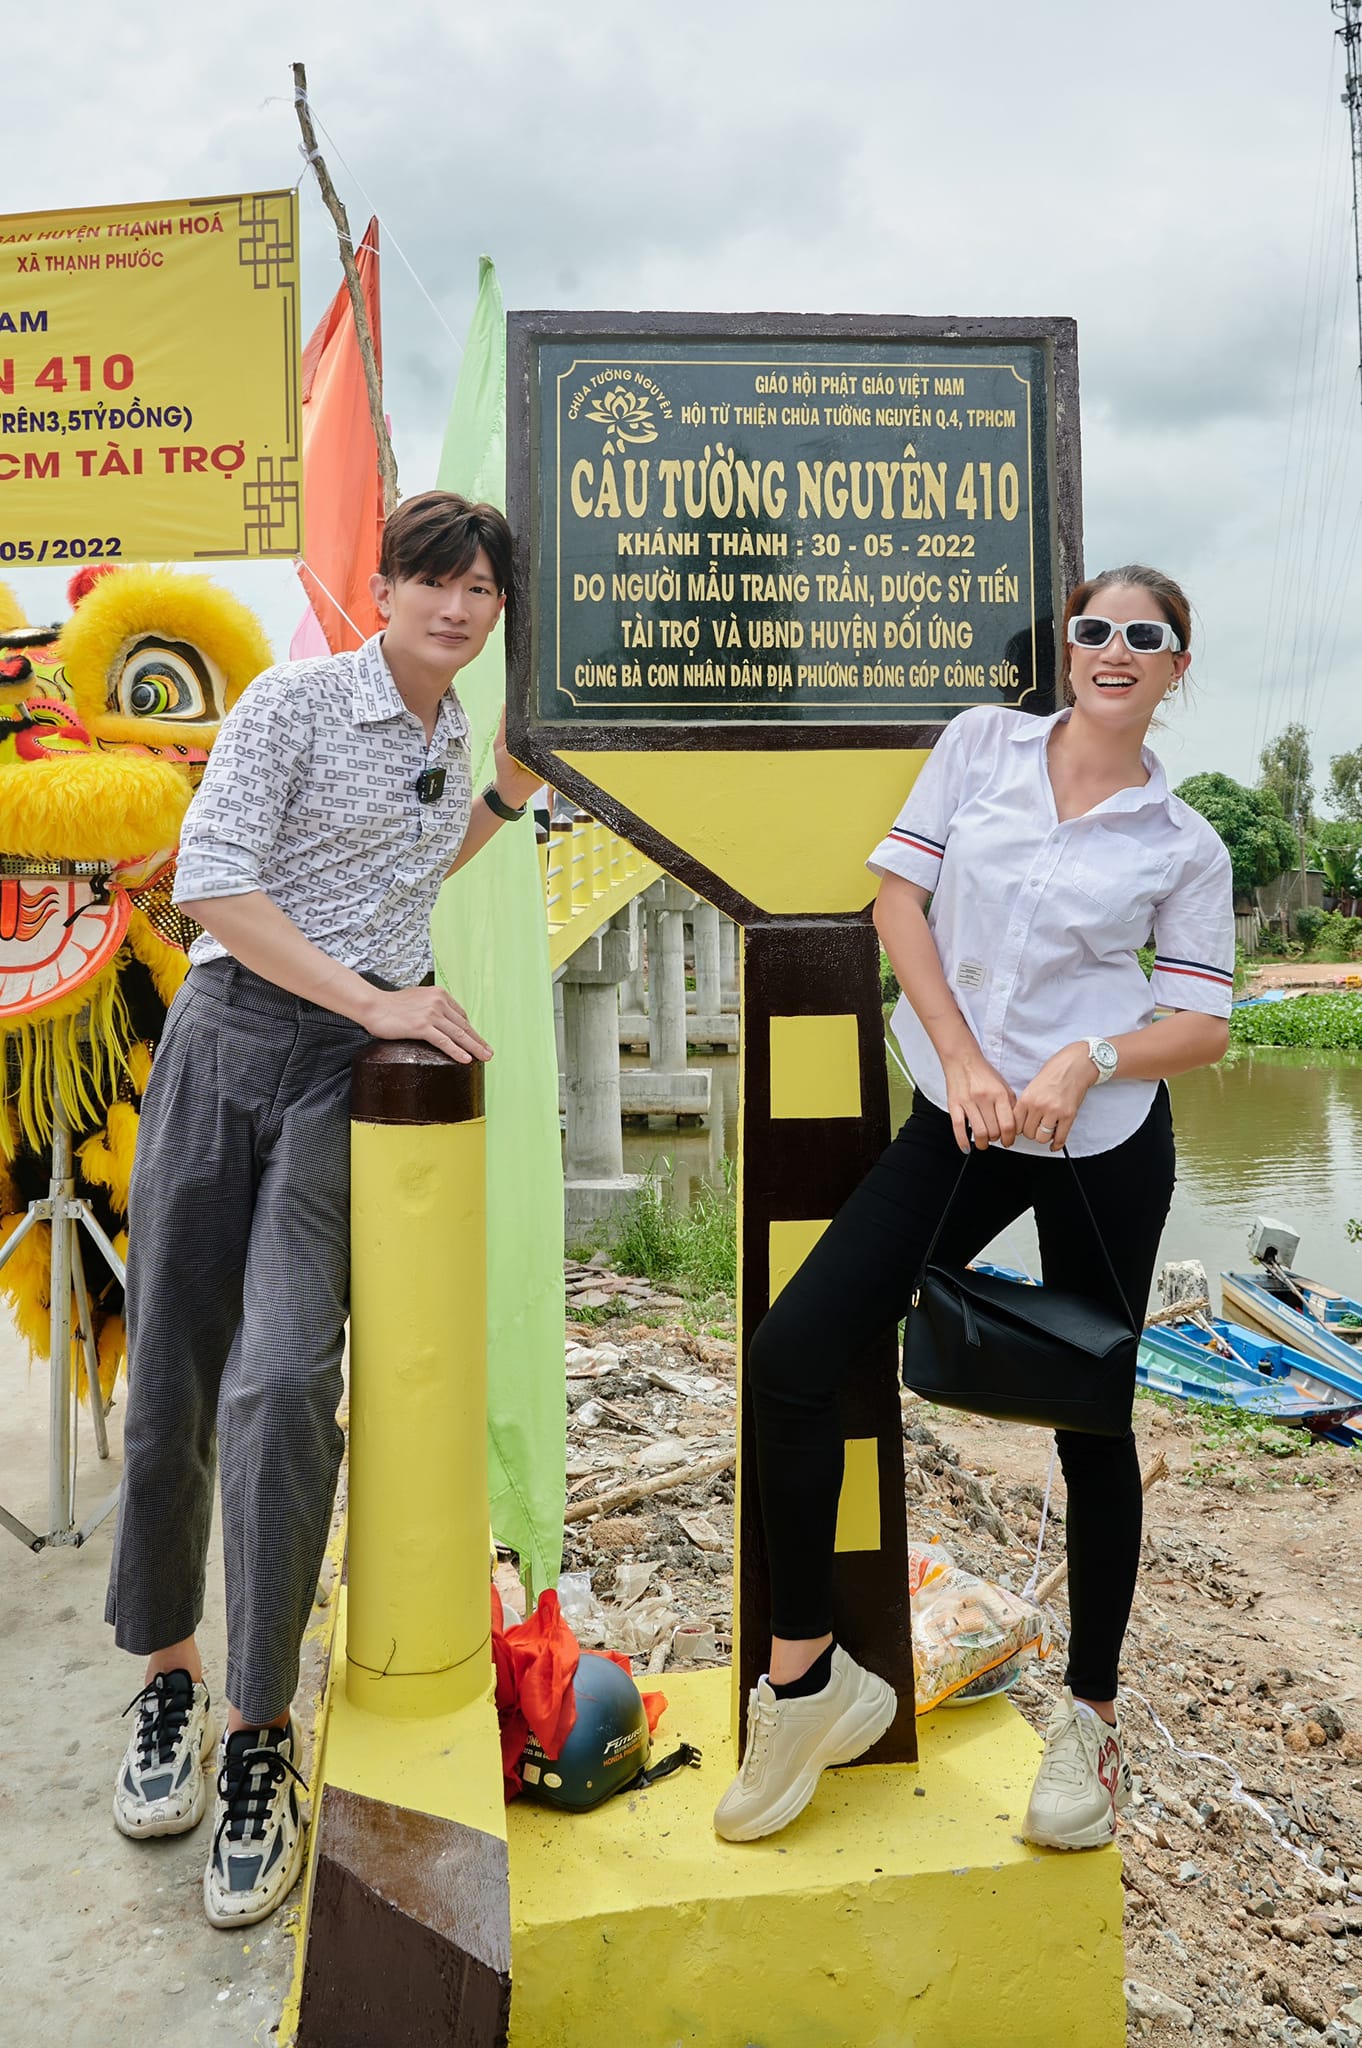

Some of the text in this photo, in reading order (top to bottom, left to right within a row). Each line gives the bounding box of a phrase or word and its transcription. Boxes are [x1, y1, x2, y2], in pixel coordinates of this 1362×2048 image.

[37, 225, 101, 243] HUYỆN
[107, 219, 172, 241] THẠNH
[180, 211, 224, 235] HOÁ
[17, 248, 164, 275] XÃ THẠNH PHƯỚC
[34, 353, 134, 393] 410
[755, 374, 965, 398] GIÁO HỘI PHẬT GIÁO VIỆT NAM
[568, 368, 673, 420] CHÙA TƯỜNG NGUYÊN
[0, 397, 192, 435] RÊN3,5TỶĐỒNG)
[681, 403, 1016, 430] HỘI TỪ THIỆN CHÙA TƯỜNG NGUYÊN Q.4, TPHCM
[76, 441, 144, 478] TÀI
[158, 440, 245, 479] TRỢ
[571, 439, 1020, 522] CẦU TƯỜNG NGUYÊN 410
[0, 537, 122, 562] 05/2022
[617, 527, 700, 556] KHÁNH
[707, 527, 788, 556] THÀNH
[812, 533, 841, 557] 30
[863, 533, 894, 557] 05
[917, 534, 976, 558] 2022
[573, 561, 1019, 611] DO NGƯỜI MẪU TRANG TRẦN, DƯỢC SỸ TIẾN
[621, 608, 973, 656] TÀI TRỢ VÀ UBND HUYỆN ĐỐI ỨNG
[574, 659, 1020, 692] CÙNG BÀ CON NHÂN DÂN ĐỊA PHƯƠNG ĐÓNG GÓP CÔNG SỨC
